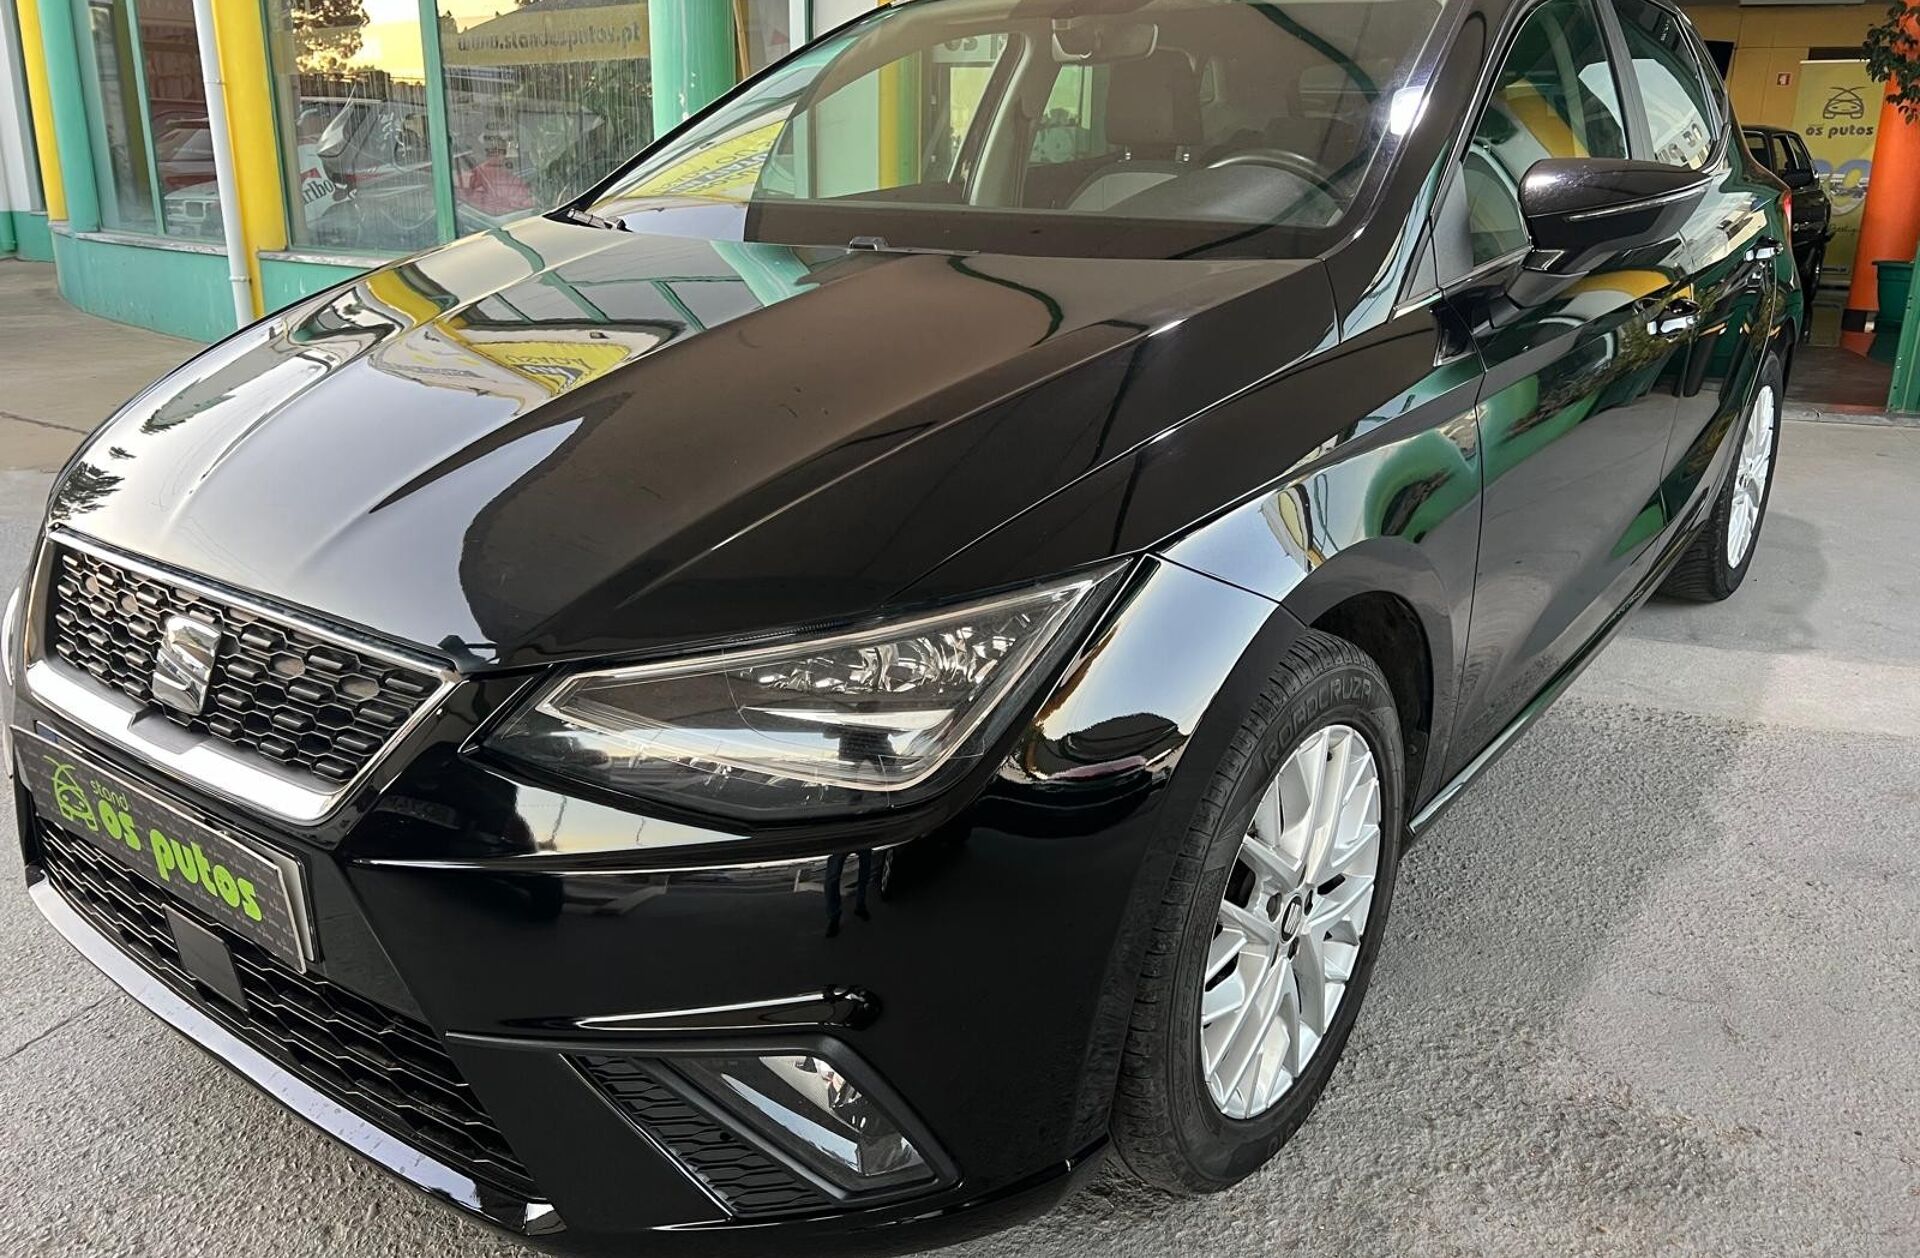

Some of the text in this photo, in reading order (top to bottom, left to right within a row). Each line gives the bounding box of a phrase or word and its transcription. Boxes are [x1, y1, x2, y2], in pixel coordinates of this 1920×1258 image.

[1805, 124, 1875, 139] os putos
[90, 779, 129, 811] stand
[149, 828, 263, 922] putos
